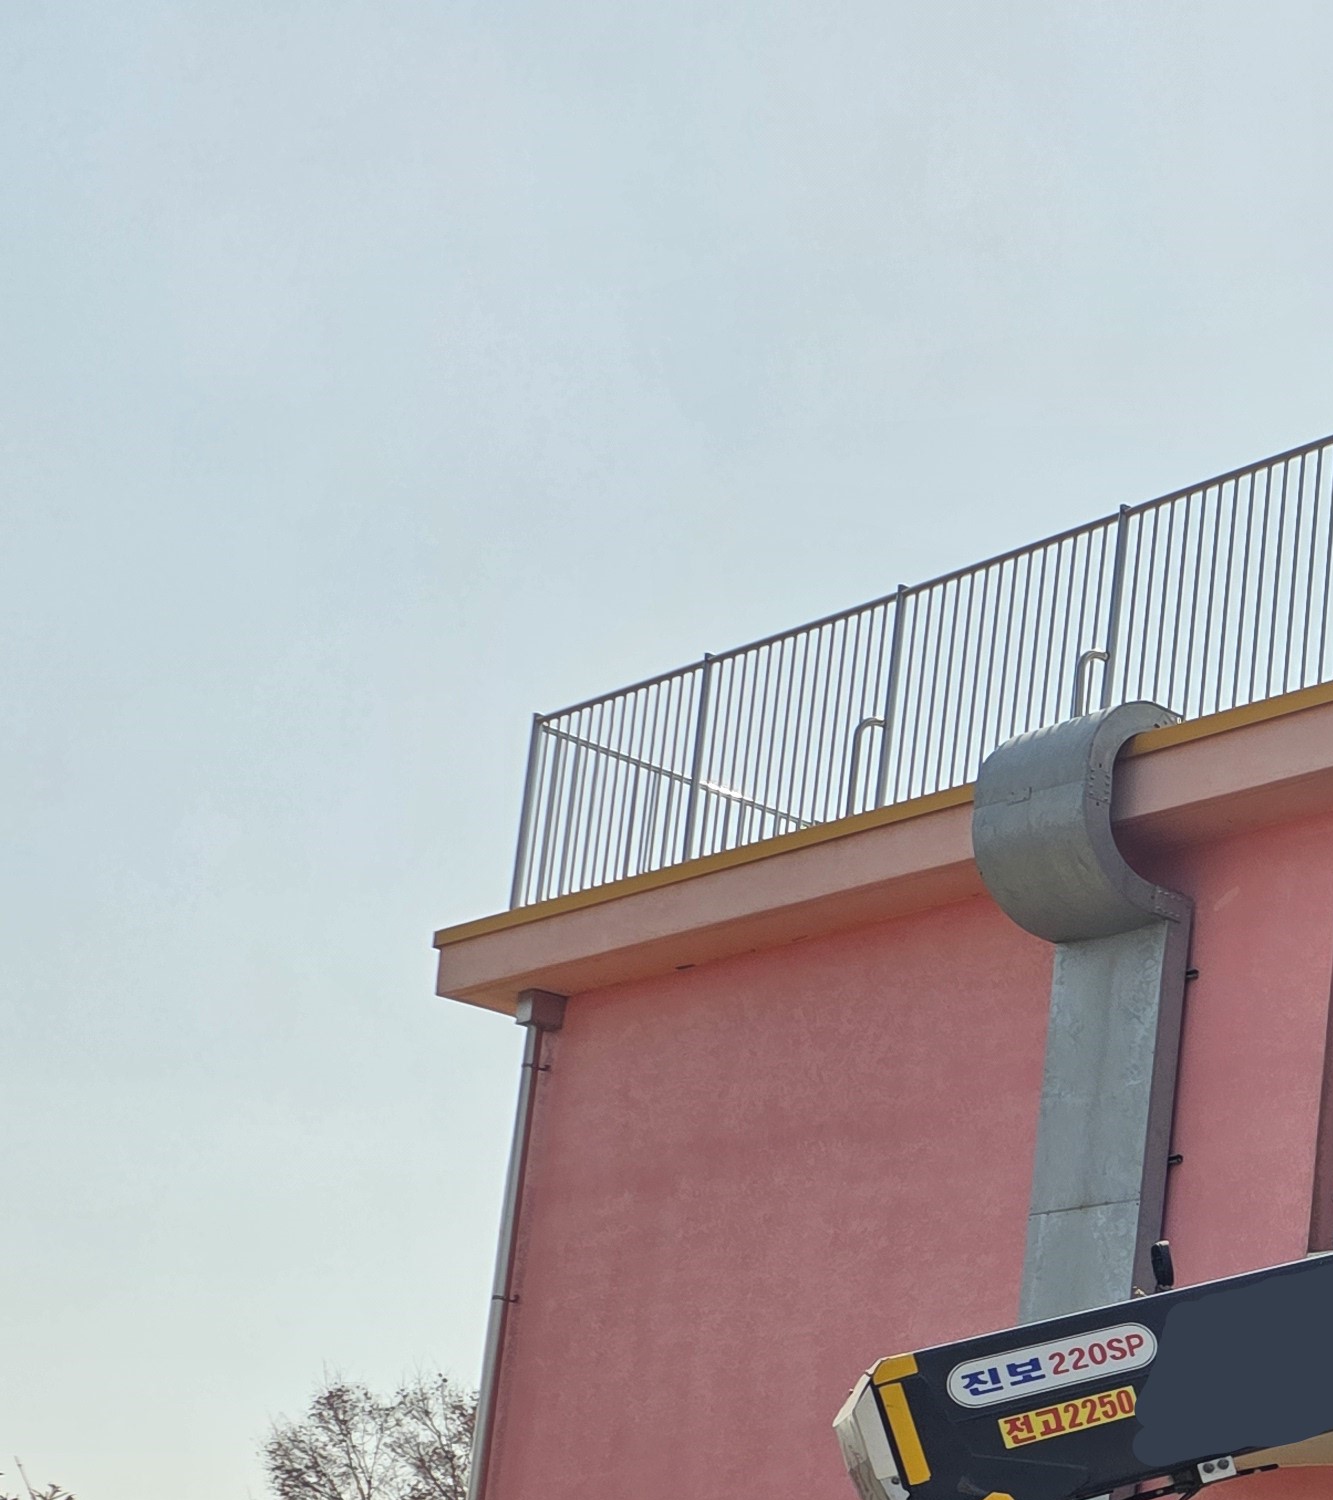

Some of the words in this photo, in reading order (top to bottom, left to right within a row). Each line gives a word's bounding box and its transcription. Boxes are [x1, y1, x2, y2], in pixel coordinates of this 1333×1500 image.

[961, 1357, 1046, 1397] 진보
[1048, 1333, 1144, 1376] 220SP
[1003, 1389, 1135, 1445] 전고2250
